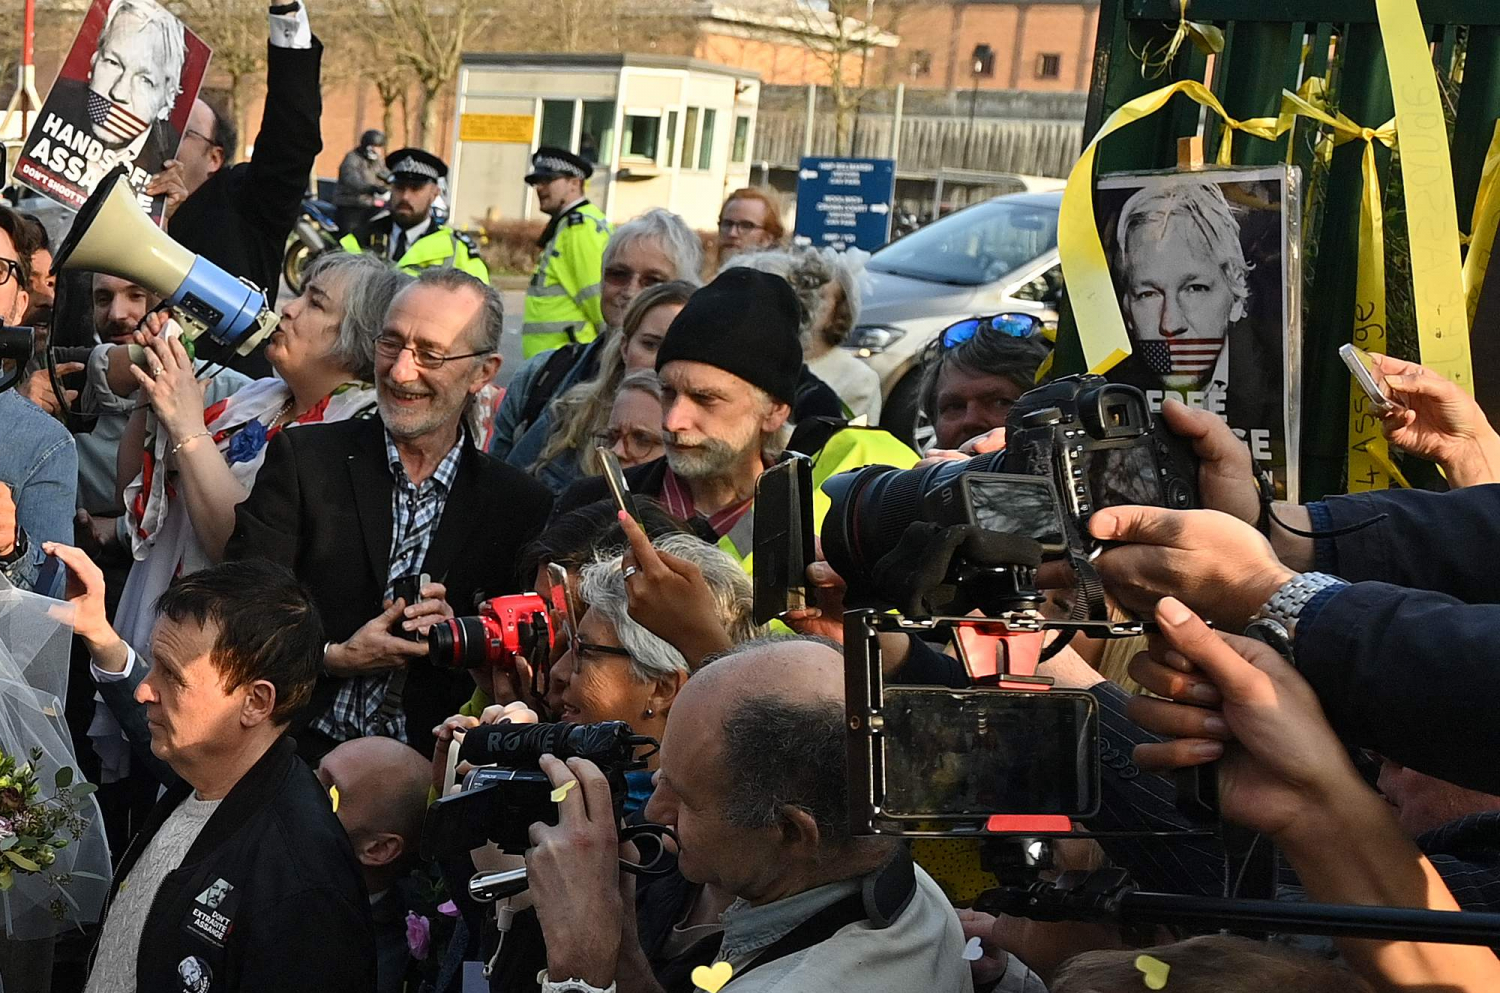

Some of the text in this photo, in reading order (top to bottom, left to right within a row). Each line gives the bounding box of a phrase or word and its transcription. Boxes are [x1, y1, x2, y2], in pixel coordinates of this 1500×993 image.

[42, 112, 117, 172] HANDS
[487, 731, 555, 752] ROE
[192, 908, 228, 933] EXTRADITE
[211, 910, 231, 925] DON'T
[194, 918, 224, 940] ASSANGE
